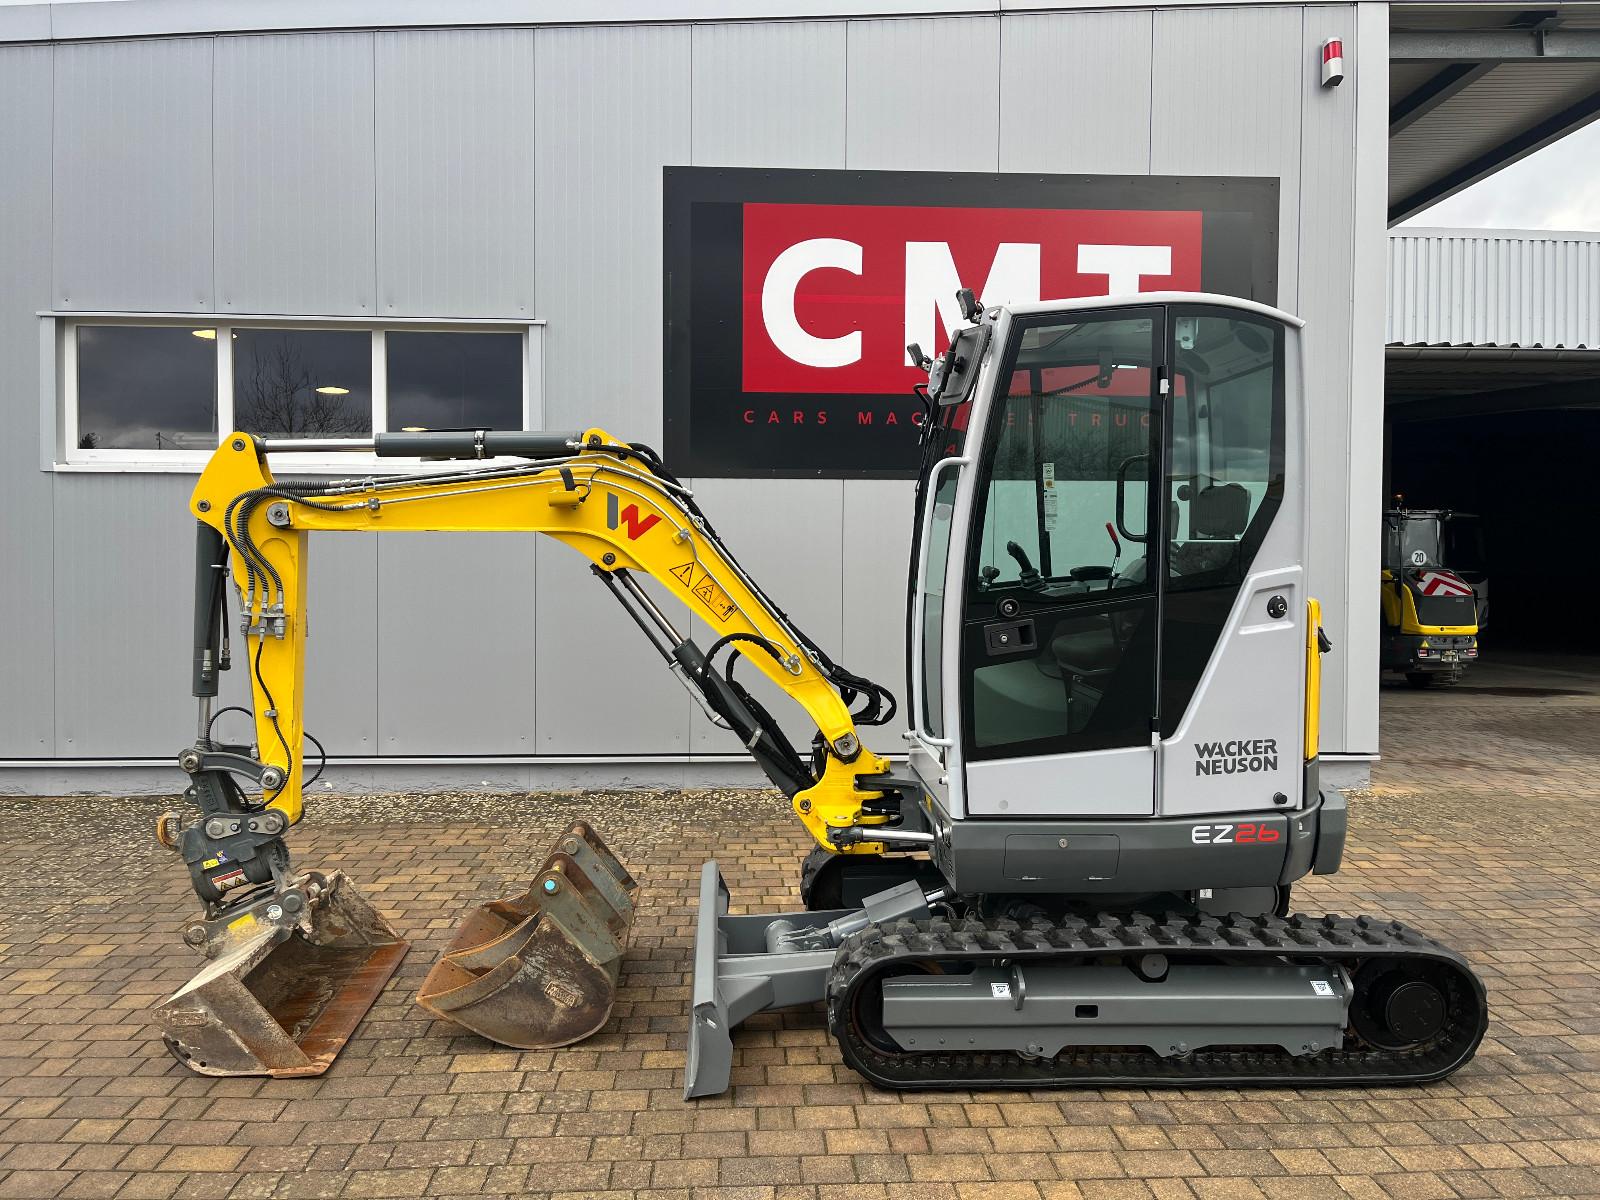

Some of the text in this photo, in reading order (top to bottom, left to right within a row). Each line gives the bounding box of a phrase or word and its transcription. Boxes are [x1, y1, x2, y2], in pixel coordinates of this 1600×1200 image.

[761, 237, 1172, 367] CMT
[743, 410, 827, 424] CARS
[1414, 552, 1424, 563] 20
[1194, 739, 1277, 758] WACKER
[1195, 756, 1277, 776] NEUSON
[1192, 824, 1279, 844] EZ26
